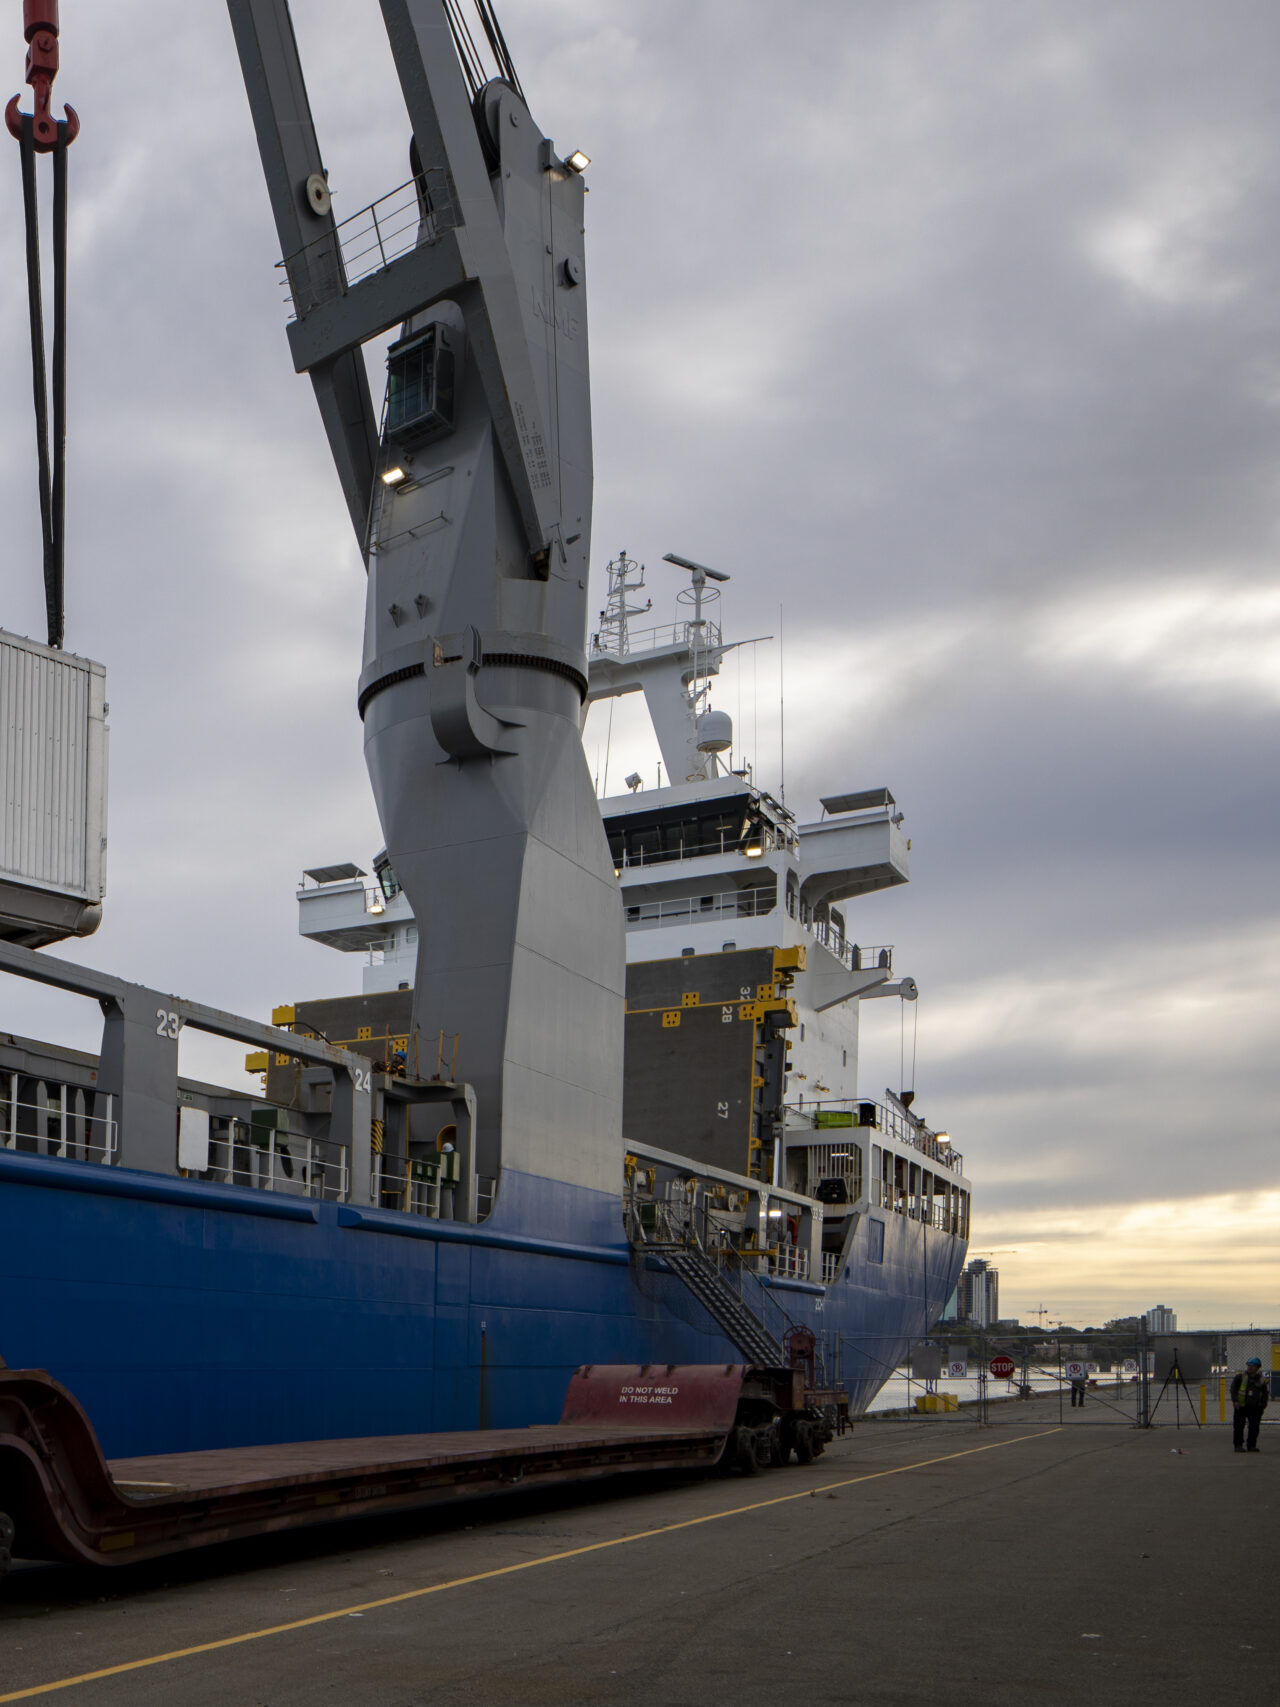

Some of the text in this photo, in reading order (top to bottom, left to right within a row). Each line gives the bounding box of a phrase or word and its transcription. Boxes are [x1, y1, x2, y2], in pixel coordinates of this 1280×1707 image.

[722, 1006, 733, 1023] 28
[156, 1009, 179, 1040] 23
[354, 1068, 371, 1094] 24
[718, 1102, 729, 1119] 27
[991, 1363, 1014, 1372] STOP
[621, 1386, 634, 1394] DO
[654, 1387, 679, 1395] WELD
[649, 1396, 673, 1404] AREA
